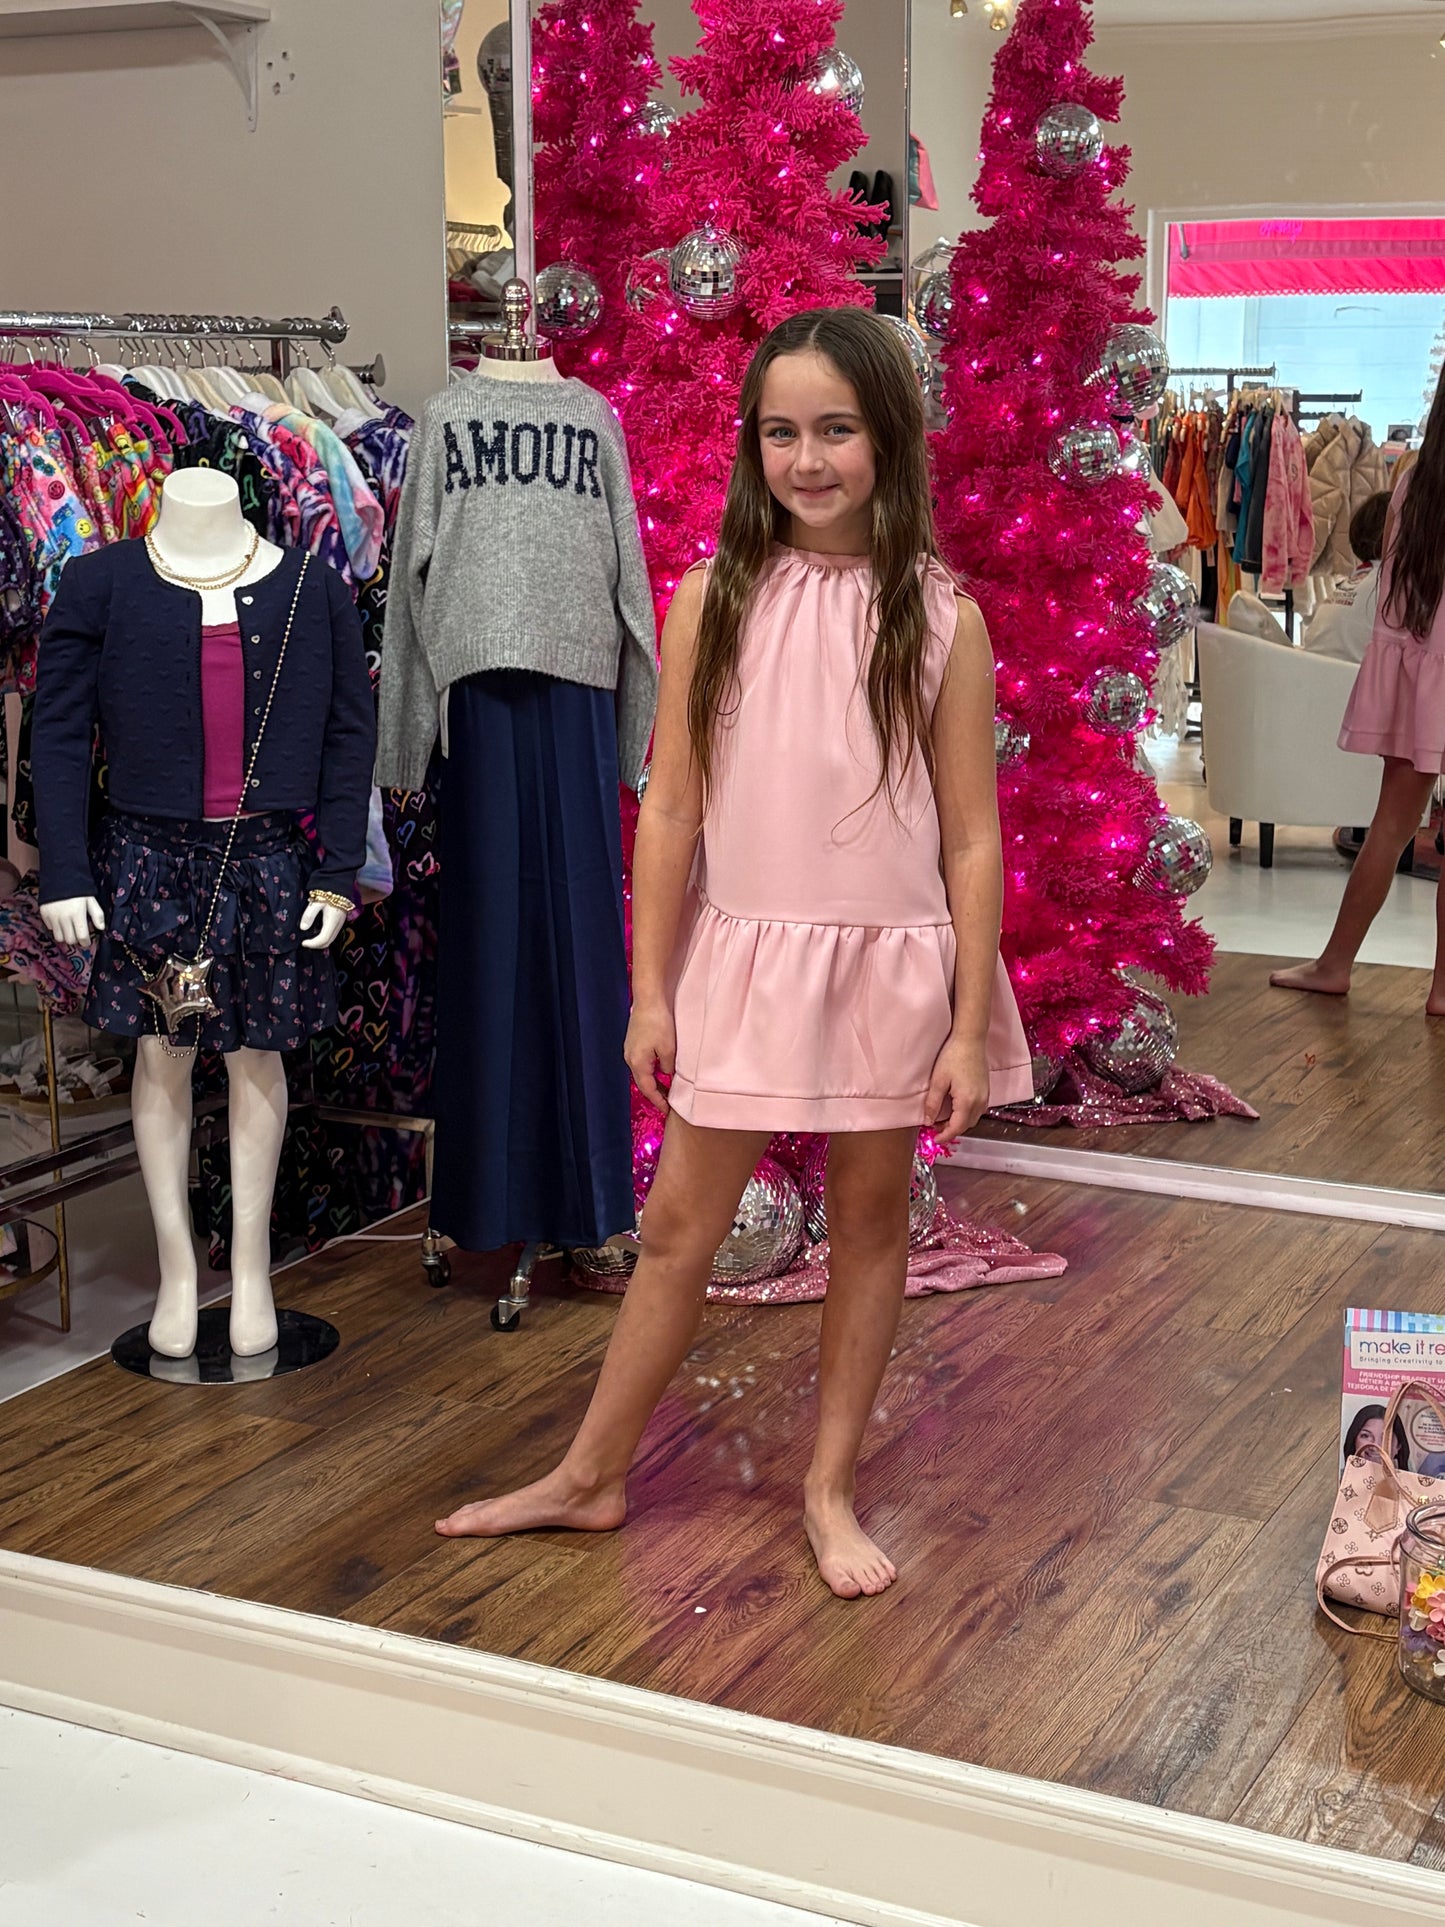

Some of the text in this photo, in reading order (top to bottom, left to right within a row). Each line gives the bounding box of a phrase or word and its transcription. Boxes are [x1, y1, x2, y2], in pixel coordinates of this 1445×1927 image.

[443, 418, 601, 498] AMOUR
[1359, 1339, 1411, 1355] make
[1416, 1339, 1425, 1355] it
[1359, 1356, 1391, 1364] Bringing
[1394, 1357, 1433, 1366] Creativity
[1359, 1371, 1400, 1380] FRIENDSHIP
